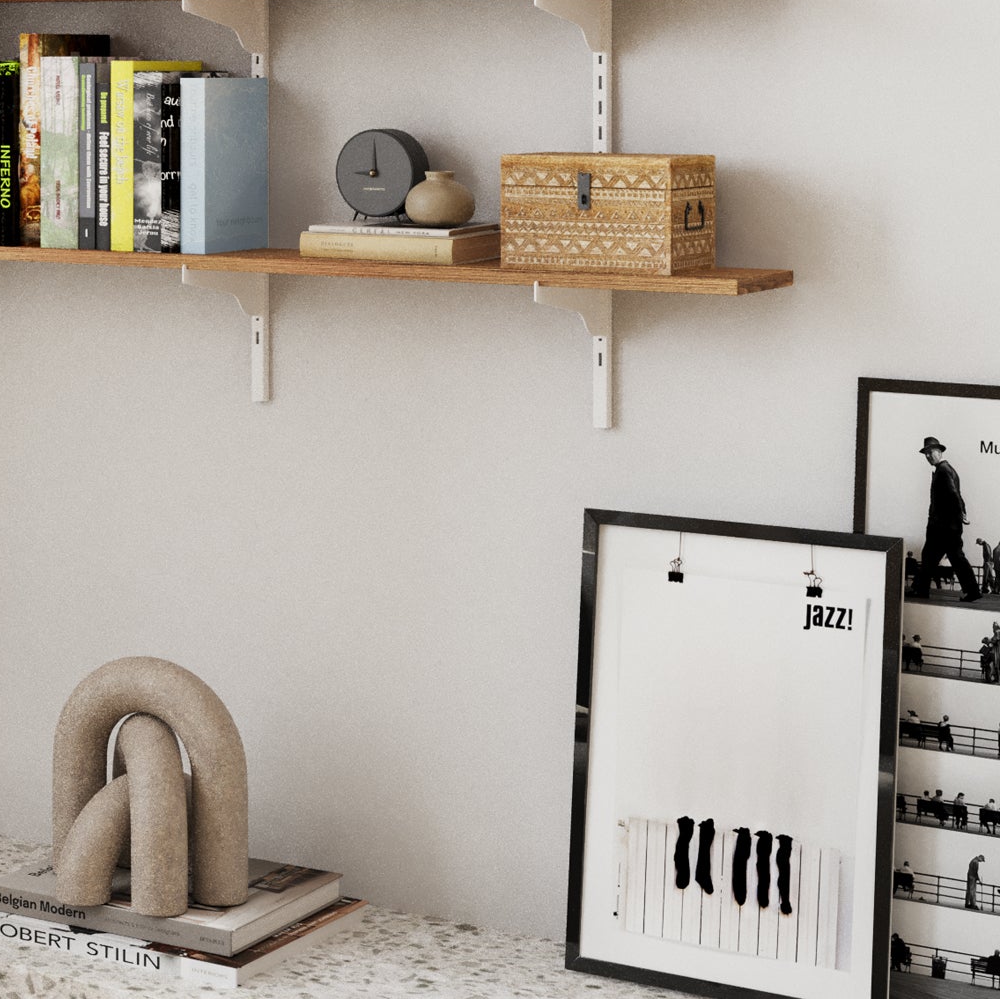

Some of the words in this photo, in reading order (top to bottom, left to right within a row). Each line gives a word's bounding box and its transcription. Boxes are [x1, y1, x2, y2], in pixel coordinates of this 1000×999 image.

[99, 99, 108, 124] prepared
[115, 79, 129, 119] Warsaw
[98, 131, 110, 147] Feel
[115, 121, 129, 133] on
[115, 136, 129, 152] the
[98, 148, 110, 175] secure
[115, 155, 129, 184] beach
[0, 145, 11, 208] INFERNO
[98, 184, 110, 201] your
[98, 203, 110, 226] house
[803, 604, 853, 631] jazz!
[39, 897, 86, 920] Modern
[86, 940, 161, 971] STILIN
